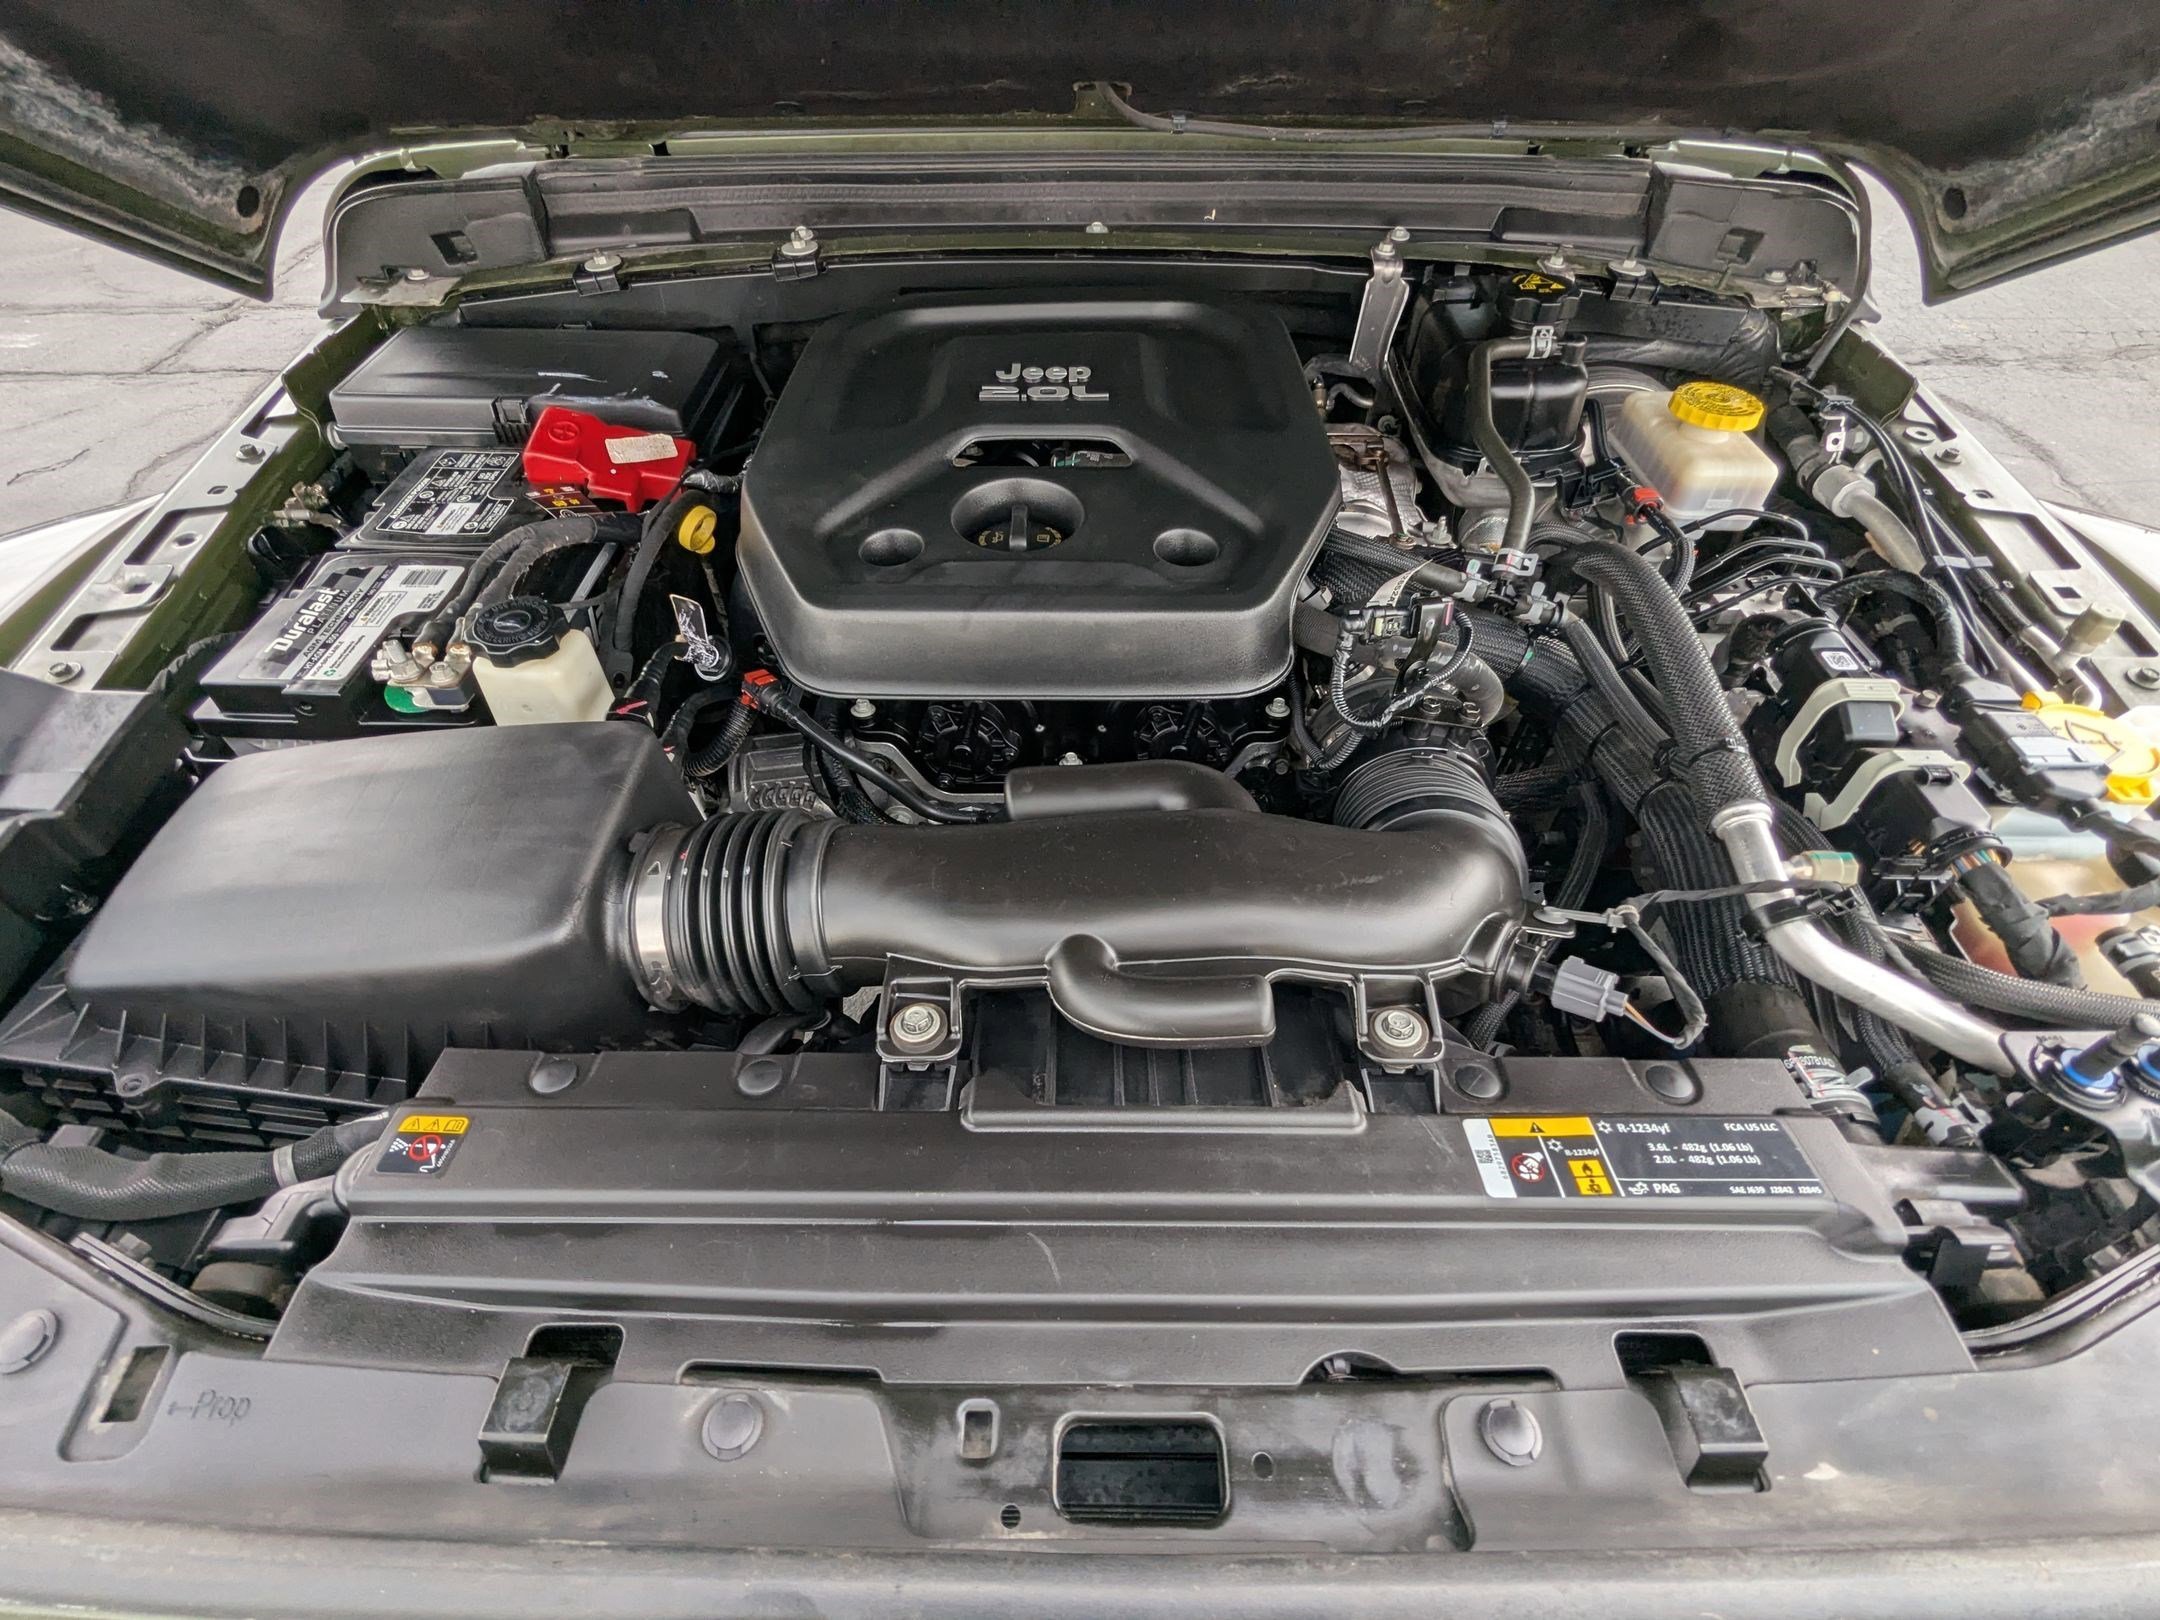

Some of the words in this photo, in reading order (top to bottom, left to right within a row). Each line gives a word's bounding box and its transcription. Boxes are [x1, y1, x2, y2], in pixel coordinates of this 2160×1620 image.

[995, 362, 1092, 385] Jeep
[979, 385, 1110, 401] 2.0L
[306, 589, 350, 635] PLATINUM
[264, 587, 340, 653] Duralast
[303, 638, 322, 657] AGM
[319, 588, 365, 638] TECHNOLOGY
[1616, 1122, 1672, 1136] R-1234yf
[1723, 1122, 1745, 1132] FCA
[1744, 1123, 1760, 1132] US
[1759, 1122, 1780, 1132] LLC
[1564, 1147, 1601, 1158] R-1234yf
[1646, 1142, 1671, 1152] 3.6L
[1681, 1142, 1708, 1153] 482g
[1707, 1142, 1737, 1153] (1.06
[1735, 1142, 1755, 1153] Lb)
[1652, 1154, 1678, 1164] 2.0L
[1687, 1155, 1716, 1166] 482g
[1714, 1154, 1744, 1166] (1.06
[1742, 1154, 1763, 1166] Lb)
[1652, 1182, 1682, 1195] PAG
[191, 1388, 252, 1427] Prop
